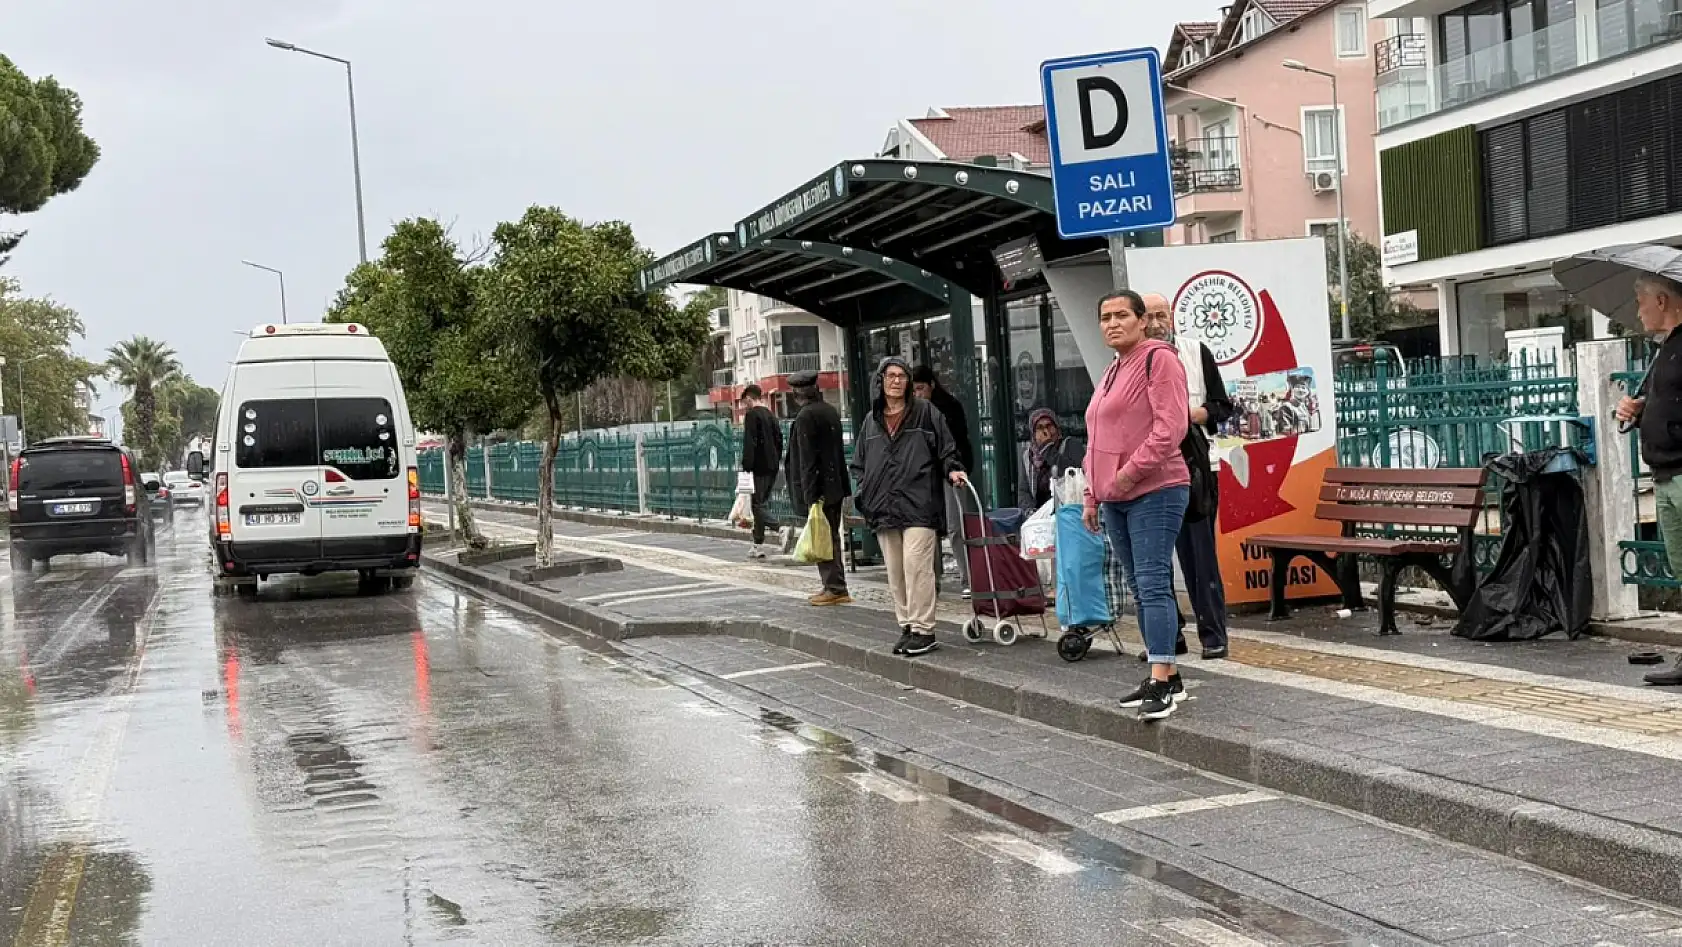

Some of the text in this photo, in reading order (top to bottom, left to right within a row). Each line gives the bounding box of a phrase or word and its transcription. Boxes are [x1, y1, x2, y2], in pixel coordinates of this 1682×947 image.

[1077, 76, 1128, 150] D
[1090, 171, 1136, 192] SALI
[1078, 194, 1153, 219] PAZARI
[1179, 277, 1226, 313] BÜYÜKŞEHİR
[1227, 282, 1252, 330] BELEDİYESİ
[1350, 487, 1371, 500] MUĞLA
[1373, 488, 1415, 502] BÜYÜKŞEHİR
[1416, 490, 1454, 502] BELEDİYESİ
